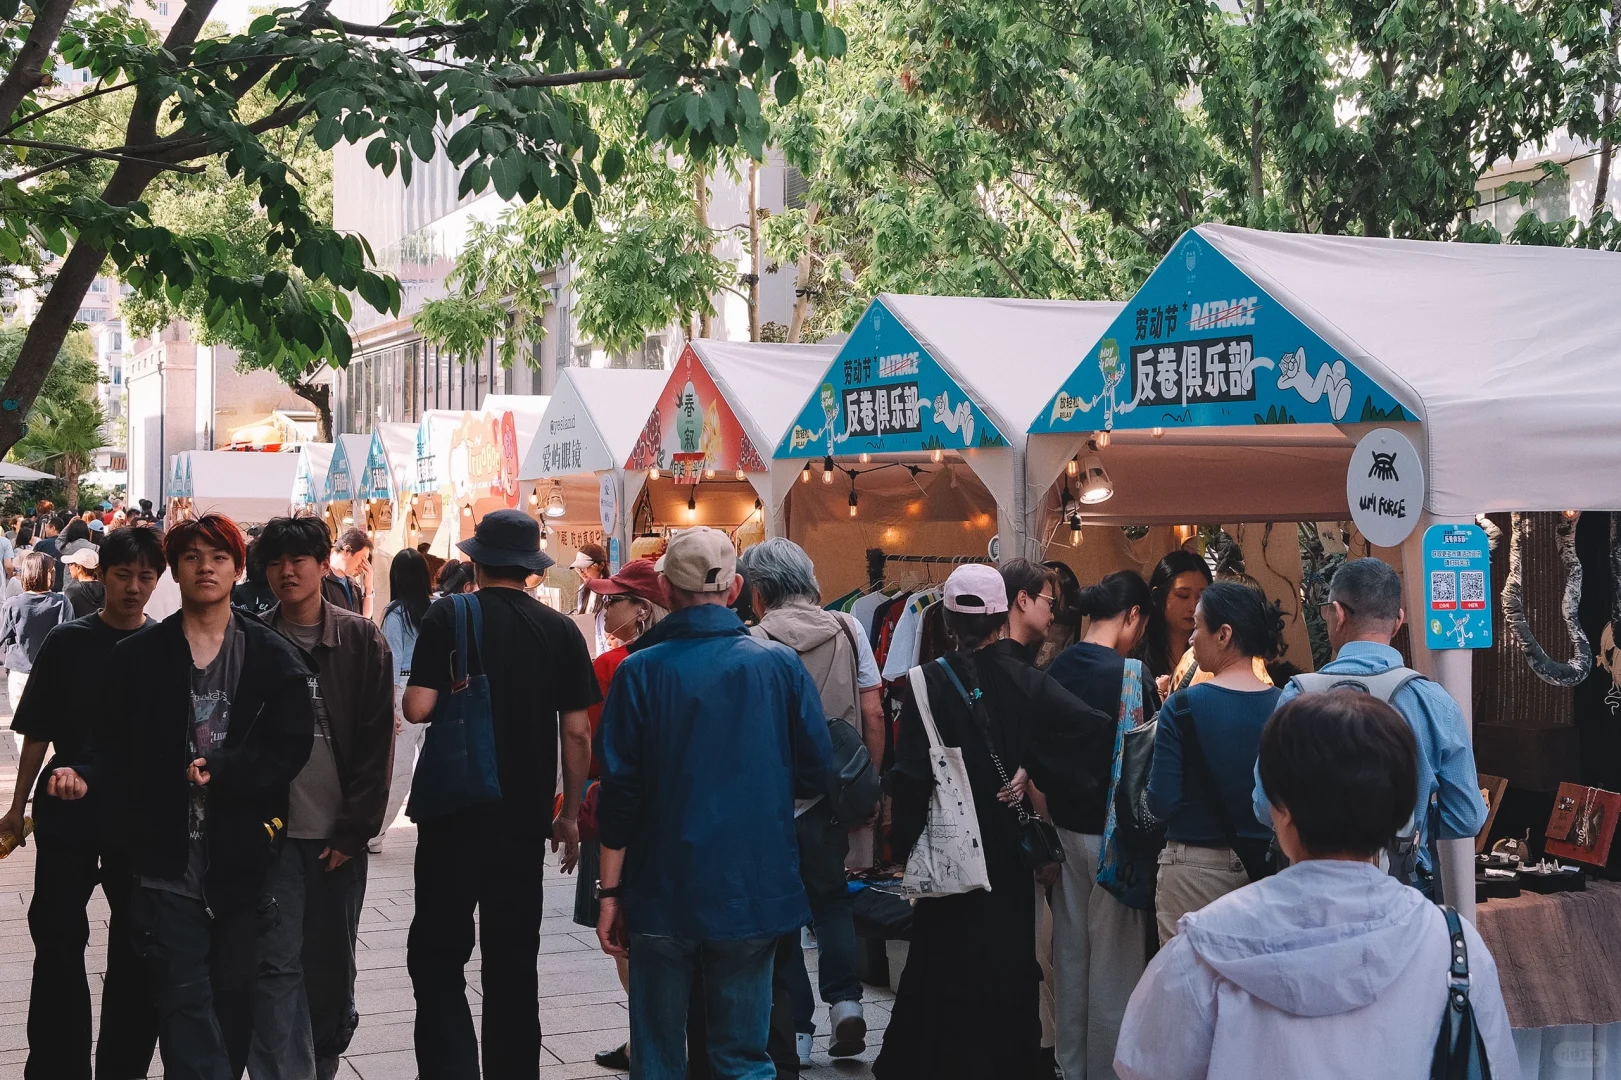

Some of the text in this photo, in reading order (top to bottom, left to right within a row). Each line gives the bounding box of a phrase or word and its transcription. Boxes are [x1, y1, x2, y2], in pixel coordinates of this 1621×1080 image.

[1135, 306, 1179, 340] 劳动节
[1189, 297, 1257, 332] RATRACE
[843, 358, 872, 385] 劳动节
[1135, 341, 1253, 406] 反卷俱乐部
[845, 386, 919, 436] 反卷俱乐部
[1059, 395, 1080, 410] 放轻松
